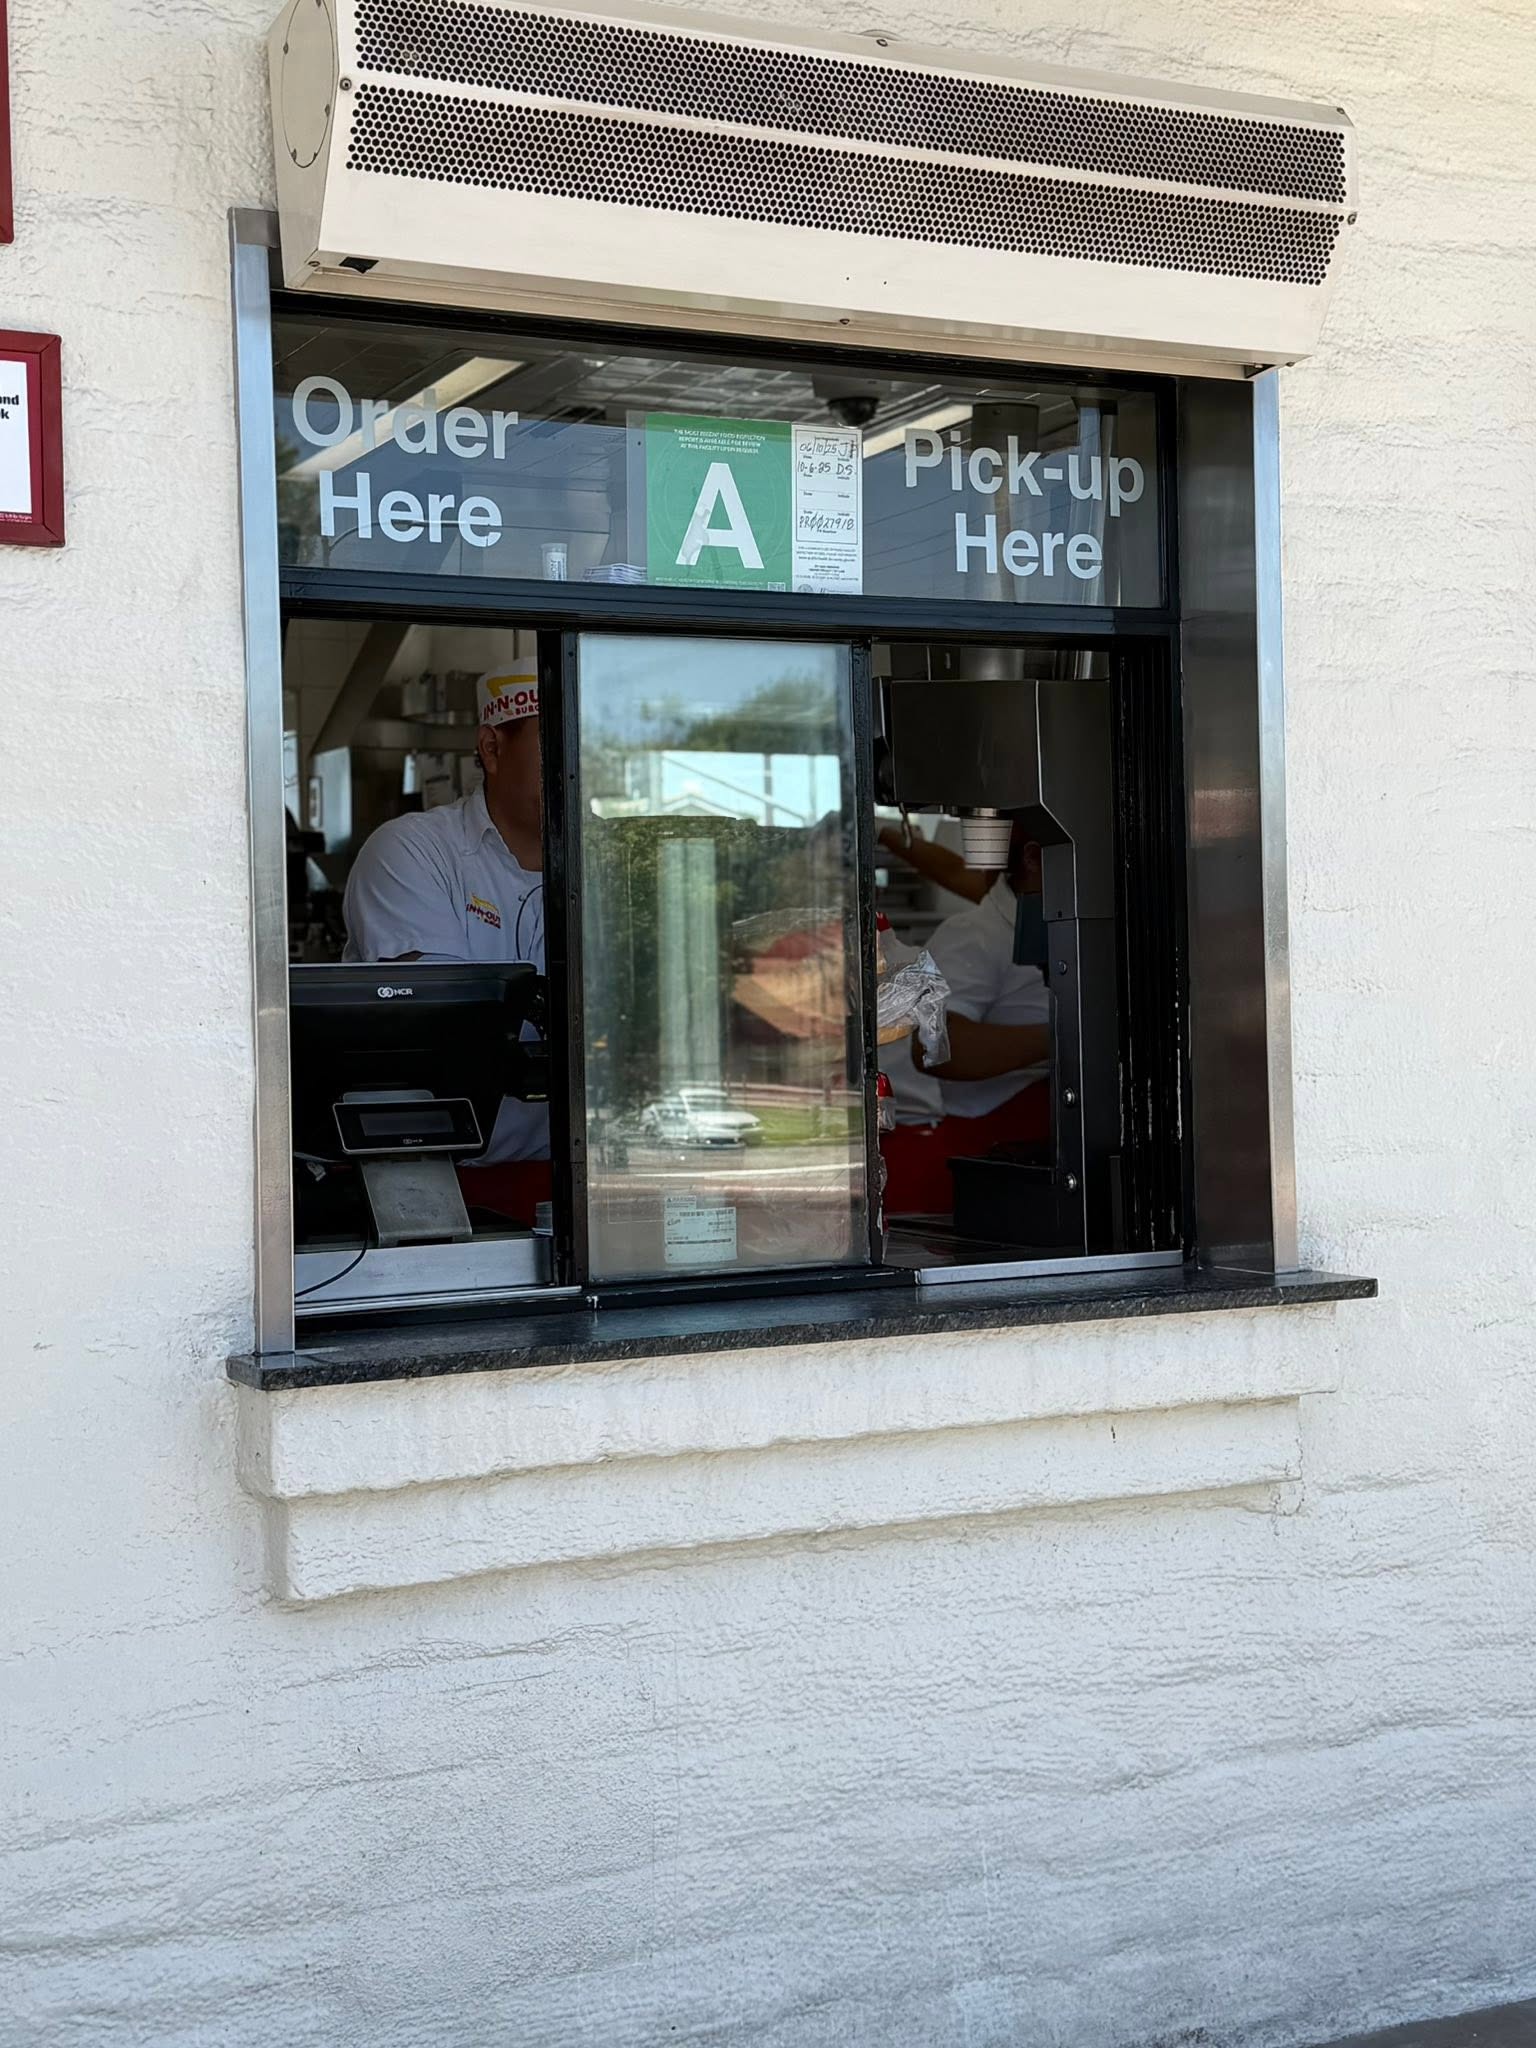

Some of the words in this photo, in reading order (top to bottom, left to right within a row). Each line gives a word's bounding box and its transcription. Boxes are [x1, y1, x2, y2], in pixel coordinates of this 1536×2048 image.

[293, 375, 518, 460] Order
[319, 470, 502, 547] Here
[905, 428, 1144, 517] Pick-up
[676, 462, 764, 568] A
[955, 512, 1102, 579] Here
[483, 689, 539, 720] IN-N-OU
[394, 987, 414, 996] NCR
